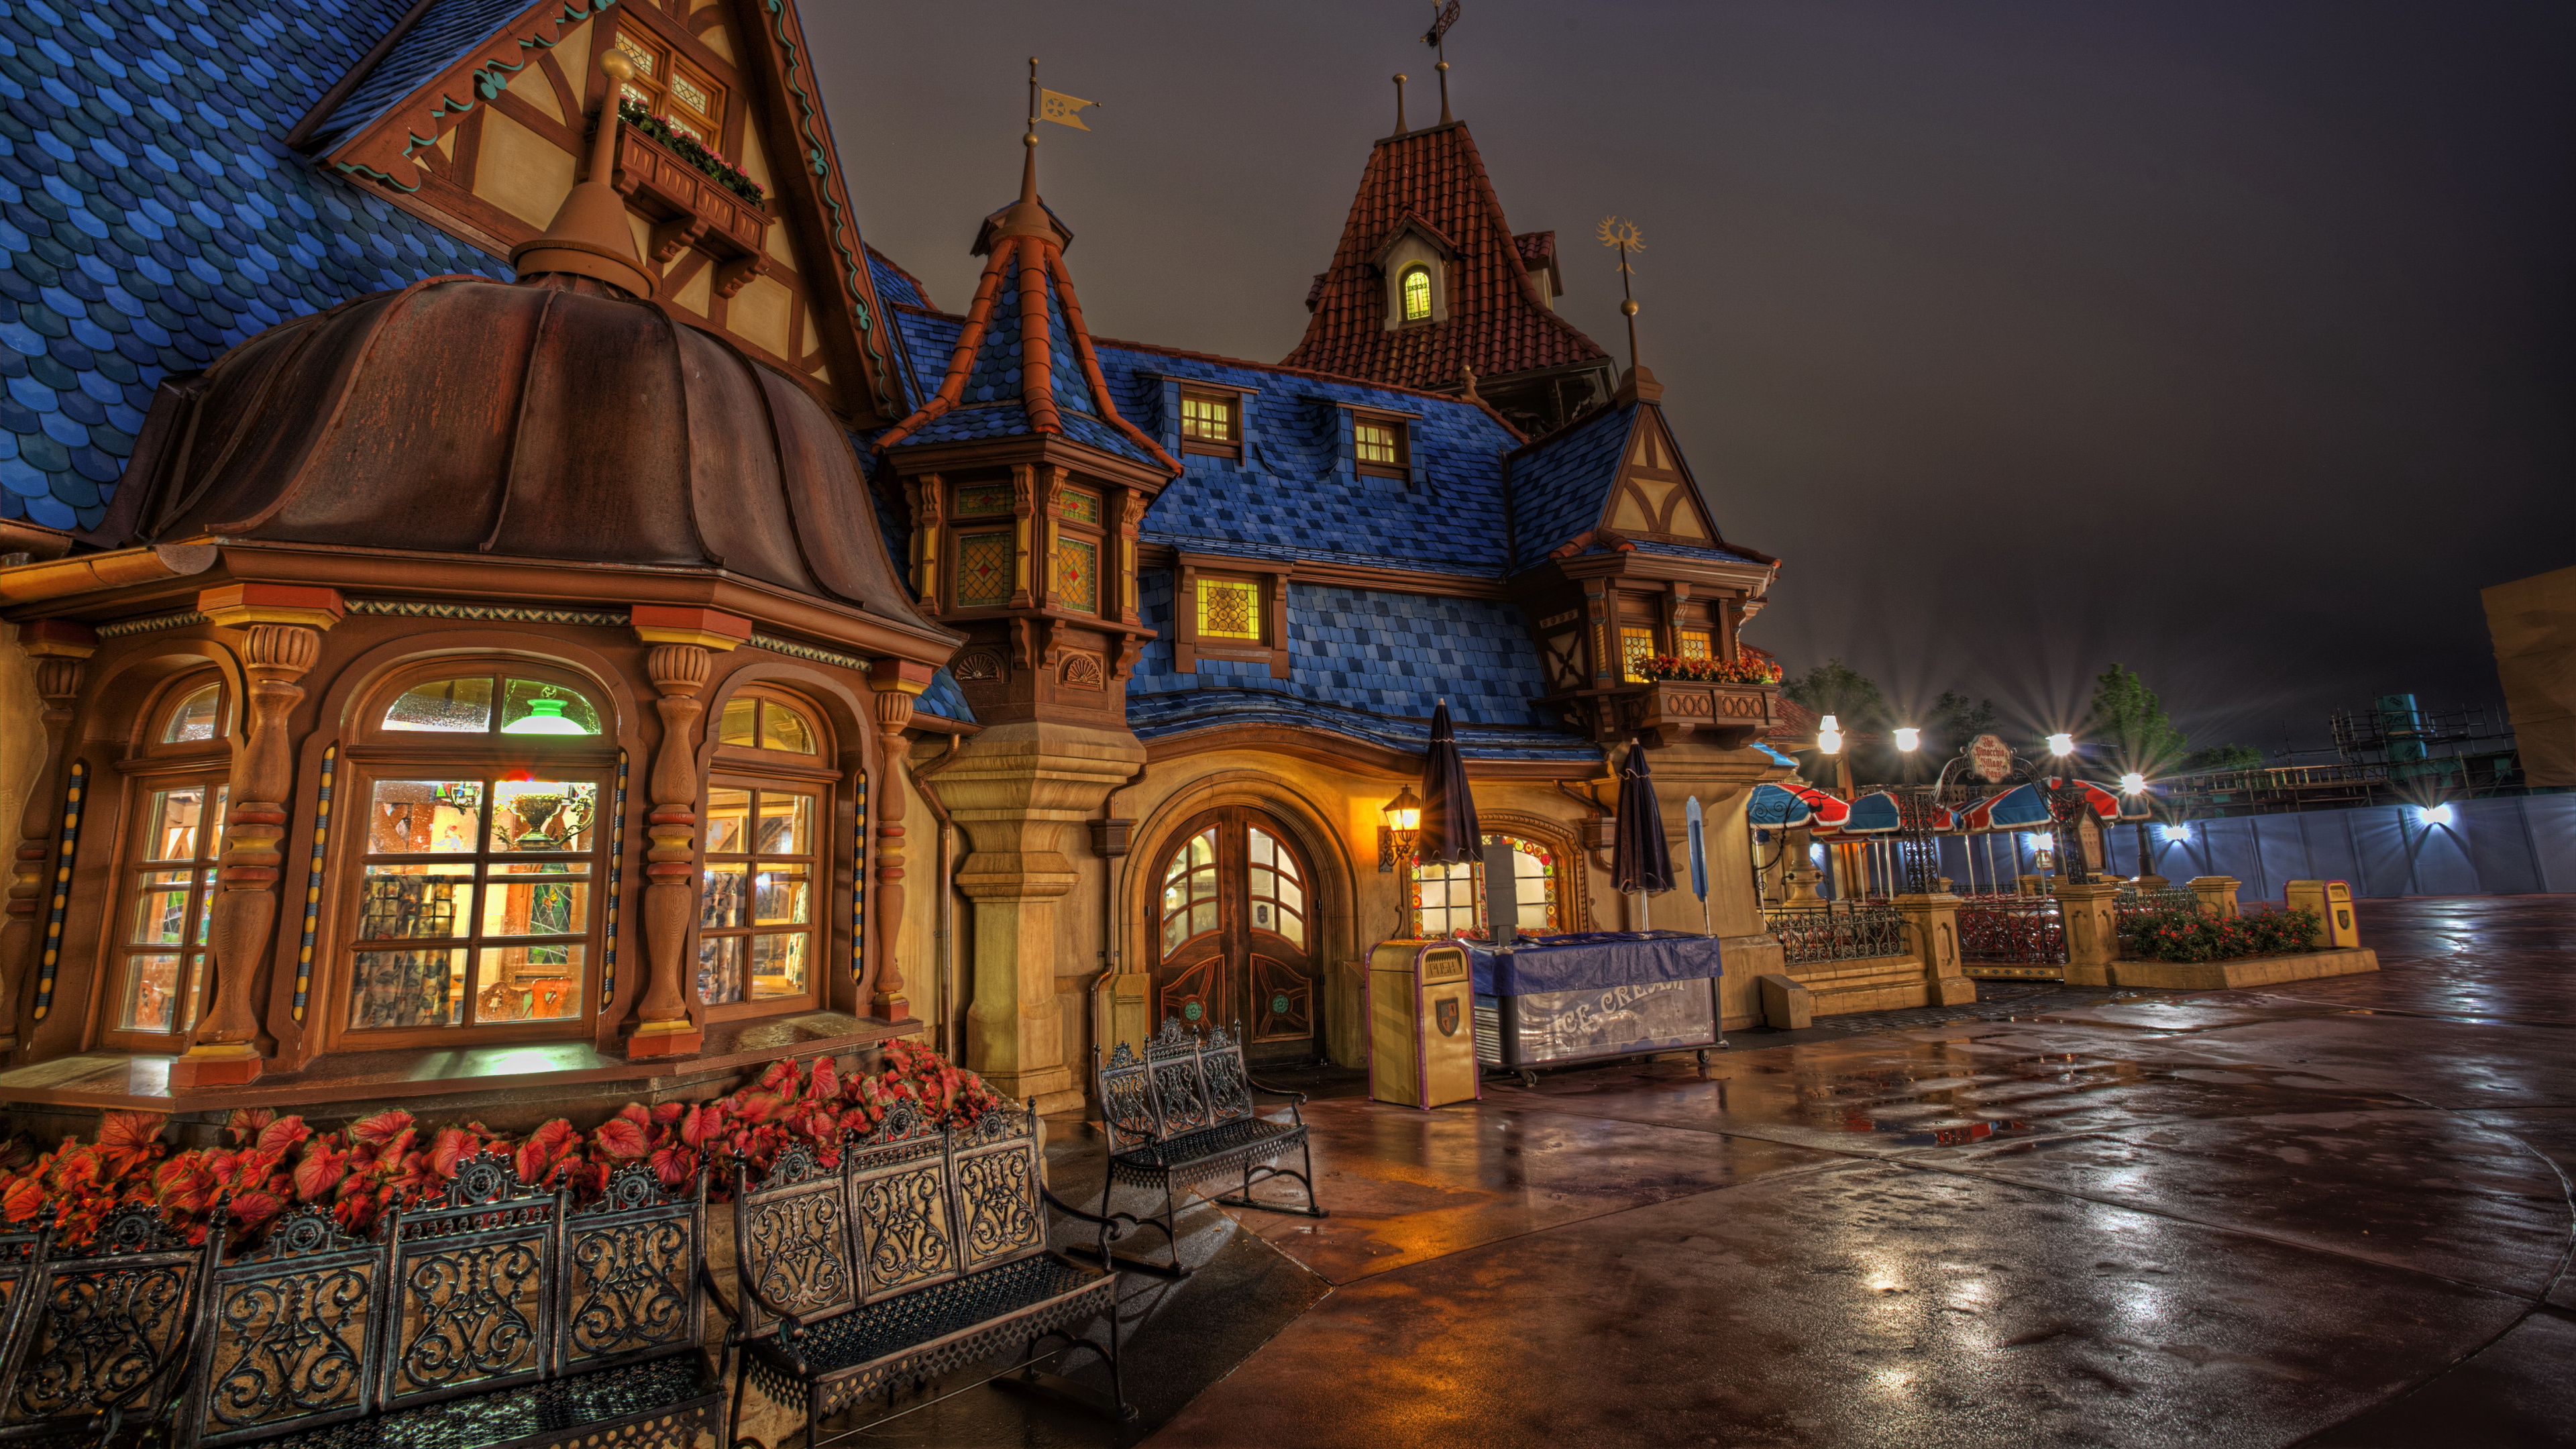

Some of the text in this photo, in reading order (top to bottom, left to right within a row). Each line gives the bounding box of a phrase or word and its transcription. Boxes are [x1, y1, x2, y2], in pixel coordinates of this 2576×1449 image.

[1982, 737, 1994, 747] The
[1976, 746, 2004, 759] Pinocchio
[1980, 758, 2002, 771] Village
[1429, 961, 1456, 977] PUSH
[1551, 1004, 1595, 1034] ICE
